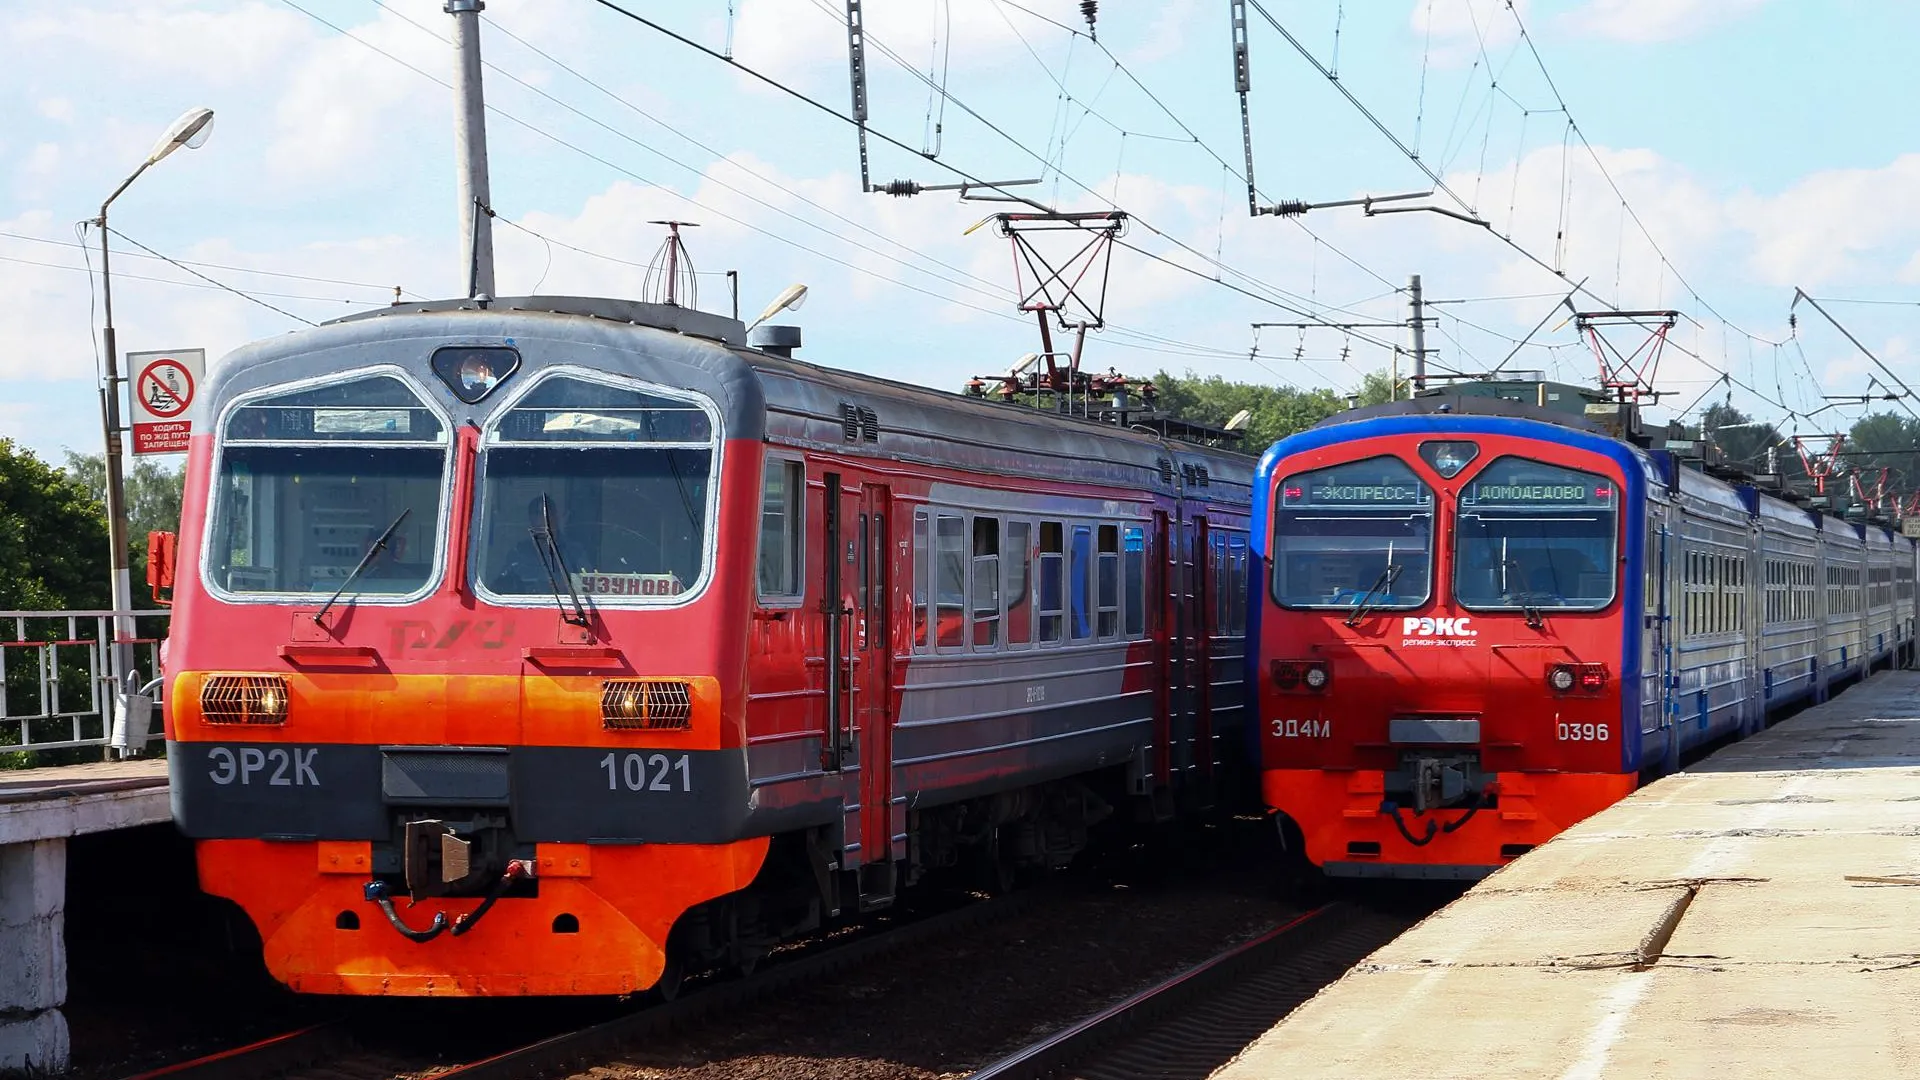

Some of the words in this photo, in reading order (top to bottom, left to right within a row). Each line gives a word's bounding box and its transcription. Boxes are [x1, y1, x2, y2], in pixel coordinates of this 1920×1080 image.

[152, 424, 185, 432] ХОДИТЬ
[140, 433, 153, 441] ПО
[1480, 486, 1585, 499] ДОМОДЕДОВО
[1403, 639, 1477, 648] регион-экспресс
[1271, 719, 1331, 738] ЭД4М
[1558, 723, 1609, 741] 0396
[207, 746, 321, 786] ЭР2К
[600, 752, 691, 792] 1021
